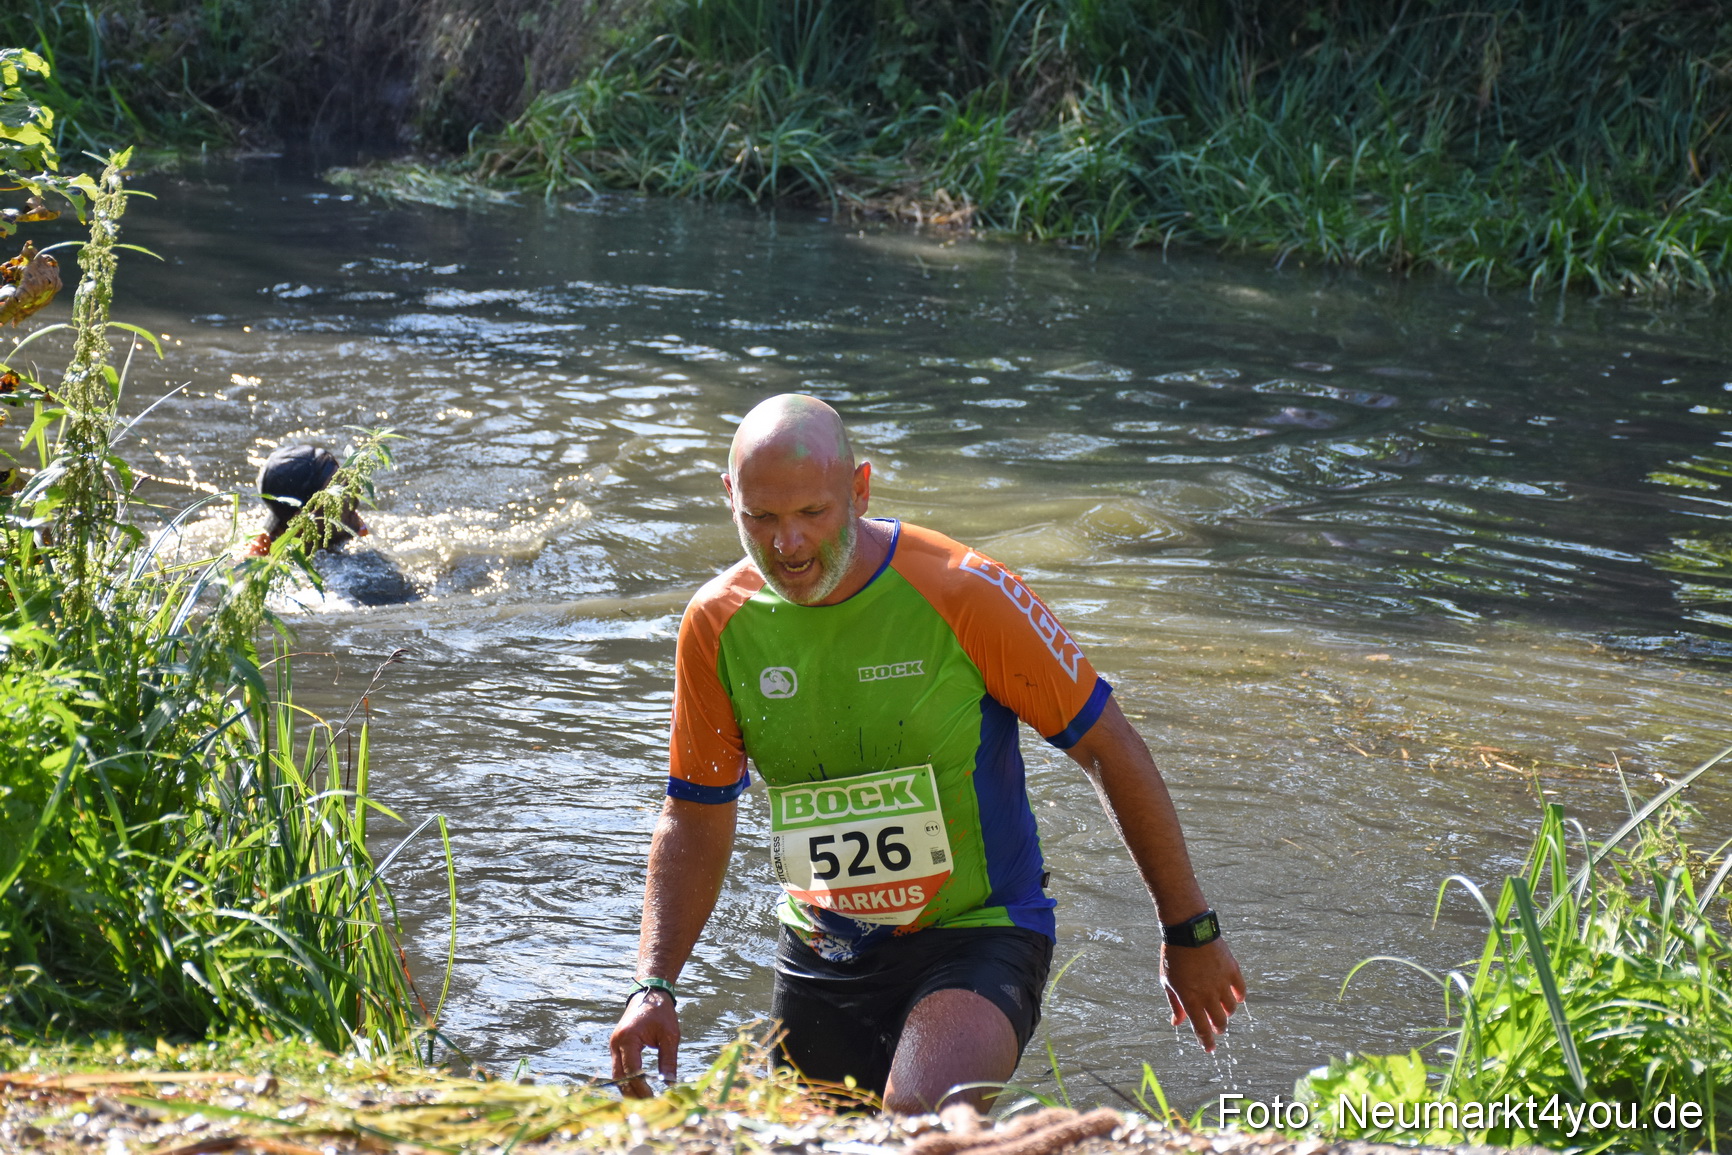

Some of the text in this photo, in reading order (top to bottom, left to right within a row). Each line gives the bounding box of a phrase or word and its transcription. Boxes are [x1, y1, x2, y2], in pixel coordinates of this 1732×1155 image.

[959, 552, 1085, 684] BOCK
[858, 660, 925, 682] BOCK
[780, 774, 924, 825] BOCK
[809, 826, 911, 880] 526
[815, 885, 925, 911] MARKUS
